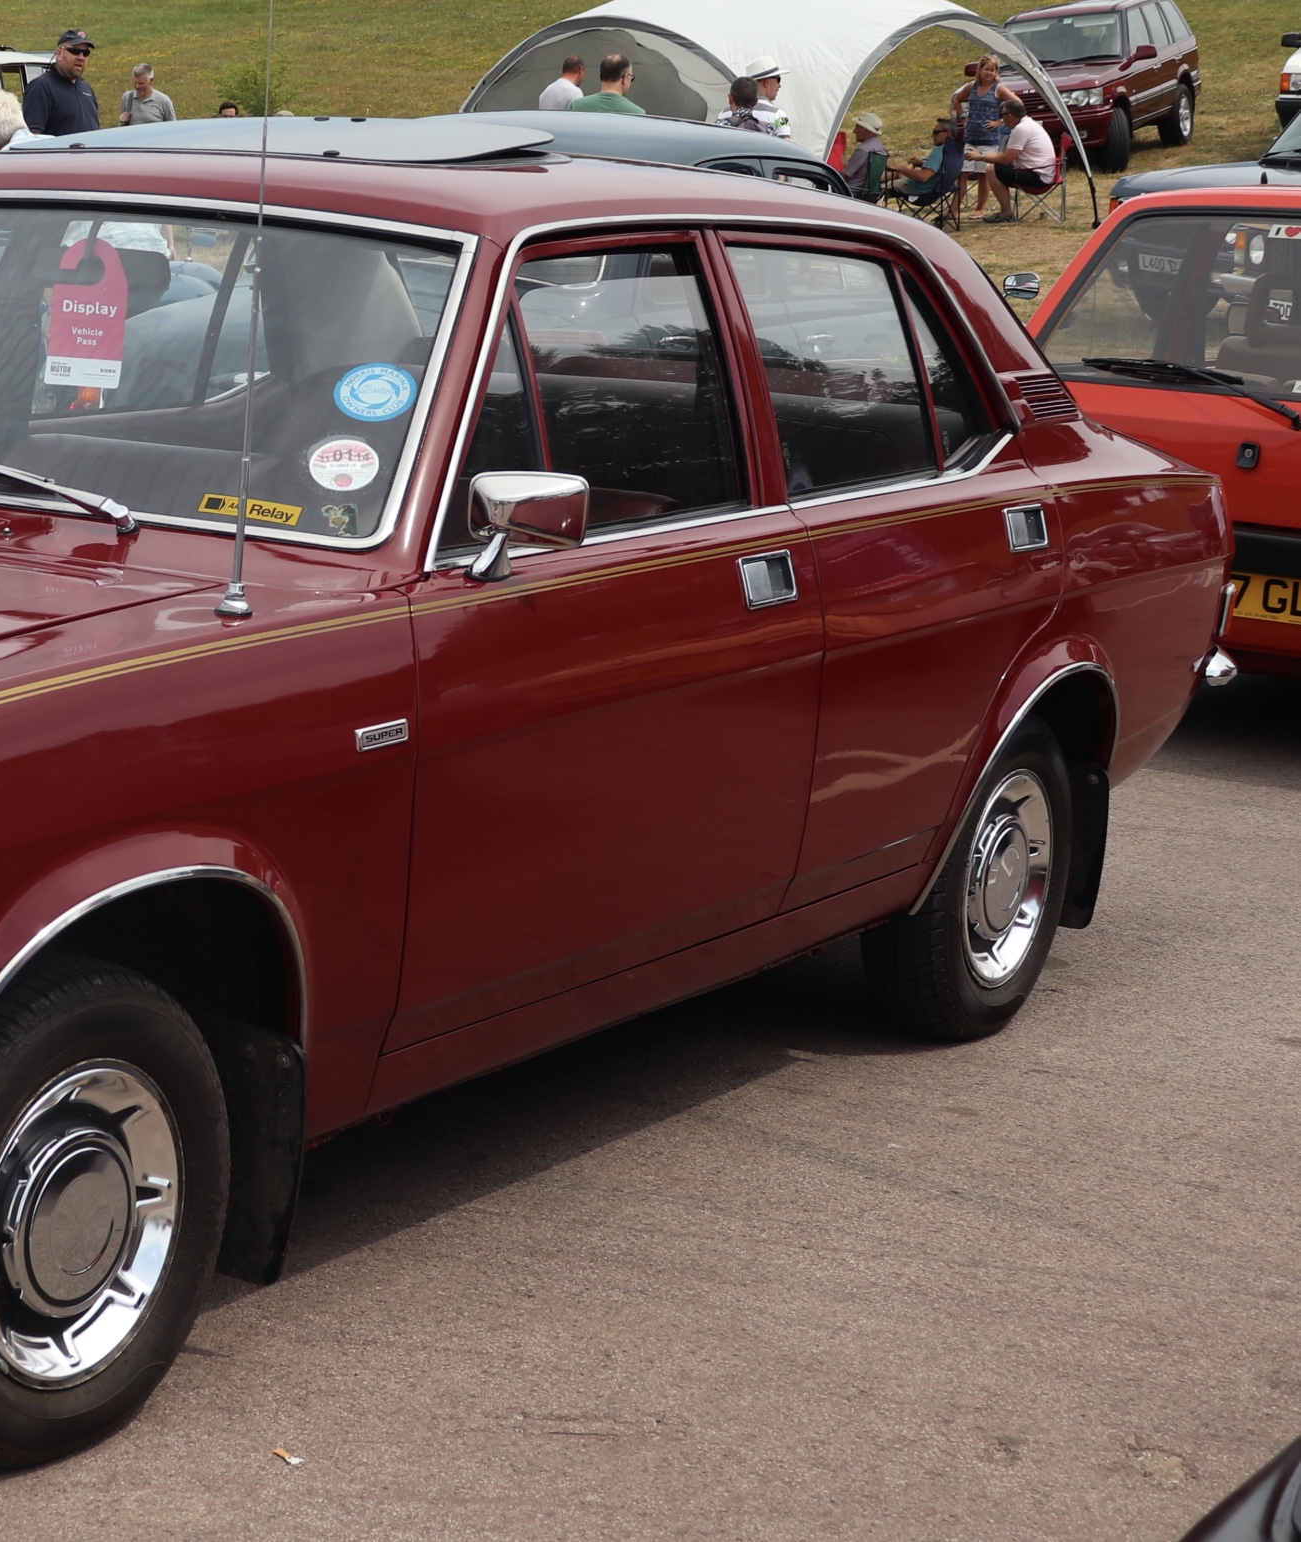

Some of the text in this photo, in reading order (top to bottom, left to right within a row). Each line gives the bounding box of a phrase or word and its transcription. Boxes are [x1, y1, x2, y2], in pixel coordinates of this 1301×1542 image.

[62, 299, 117, 317] Display
[71, 326, 104, 336] Vehicle
[76, 336, 97, 346] Pass
[49, 364, 72, 374] MOTOR
[344, 368, 409, 392] MORRIS MARINA
[342, 395, 405, 416] OWNERS CLUB
[332, 448, 352, 462] 01
[357, 452, 370, 462] 14
[249, 503, 294, 522] Relay
[365, 727, 404, 743] SUPER
